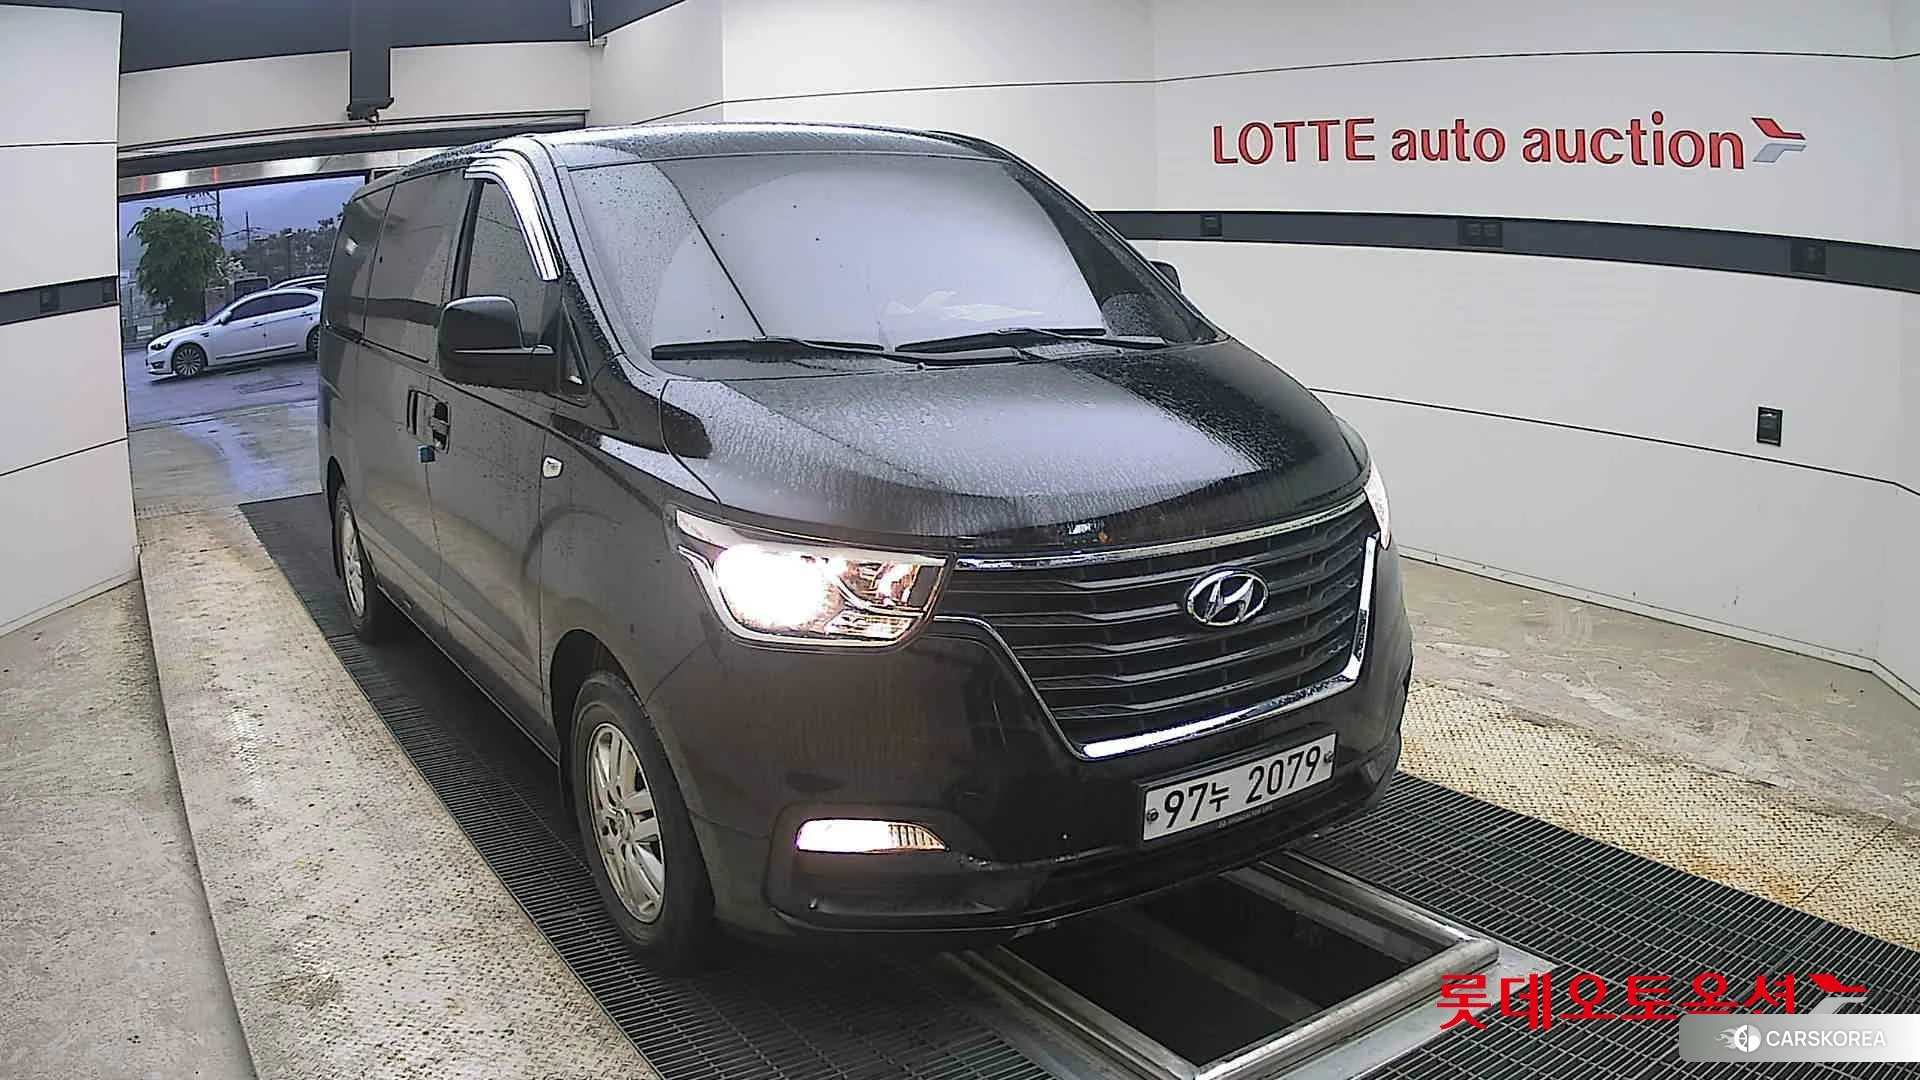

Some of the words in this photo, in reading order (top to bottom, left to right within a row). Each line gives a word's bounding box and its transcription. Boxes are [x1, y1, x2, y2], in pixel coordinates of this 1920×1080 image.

[1213, 118, 1375, 165] LOTTE
[1391, 118, 1506, 162] auto
[1522, 111, 1744, 169] auction
[1164, 782, 1230, 828] 97누
[1246, 746, 1320, 804] 2079
